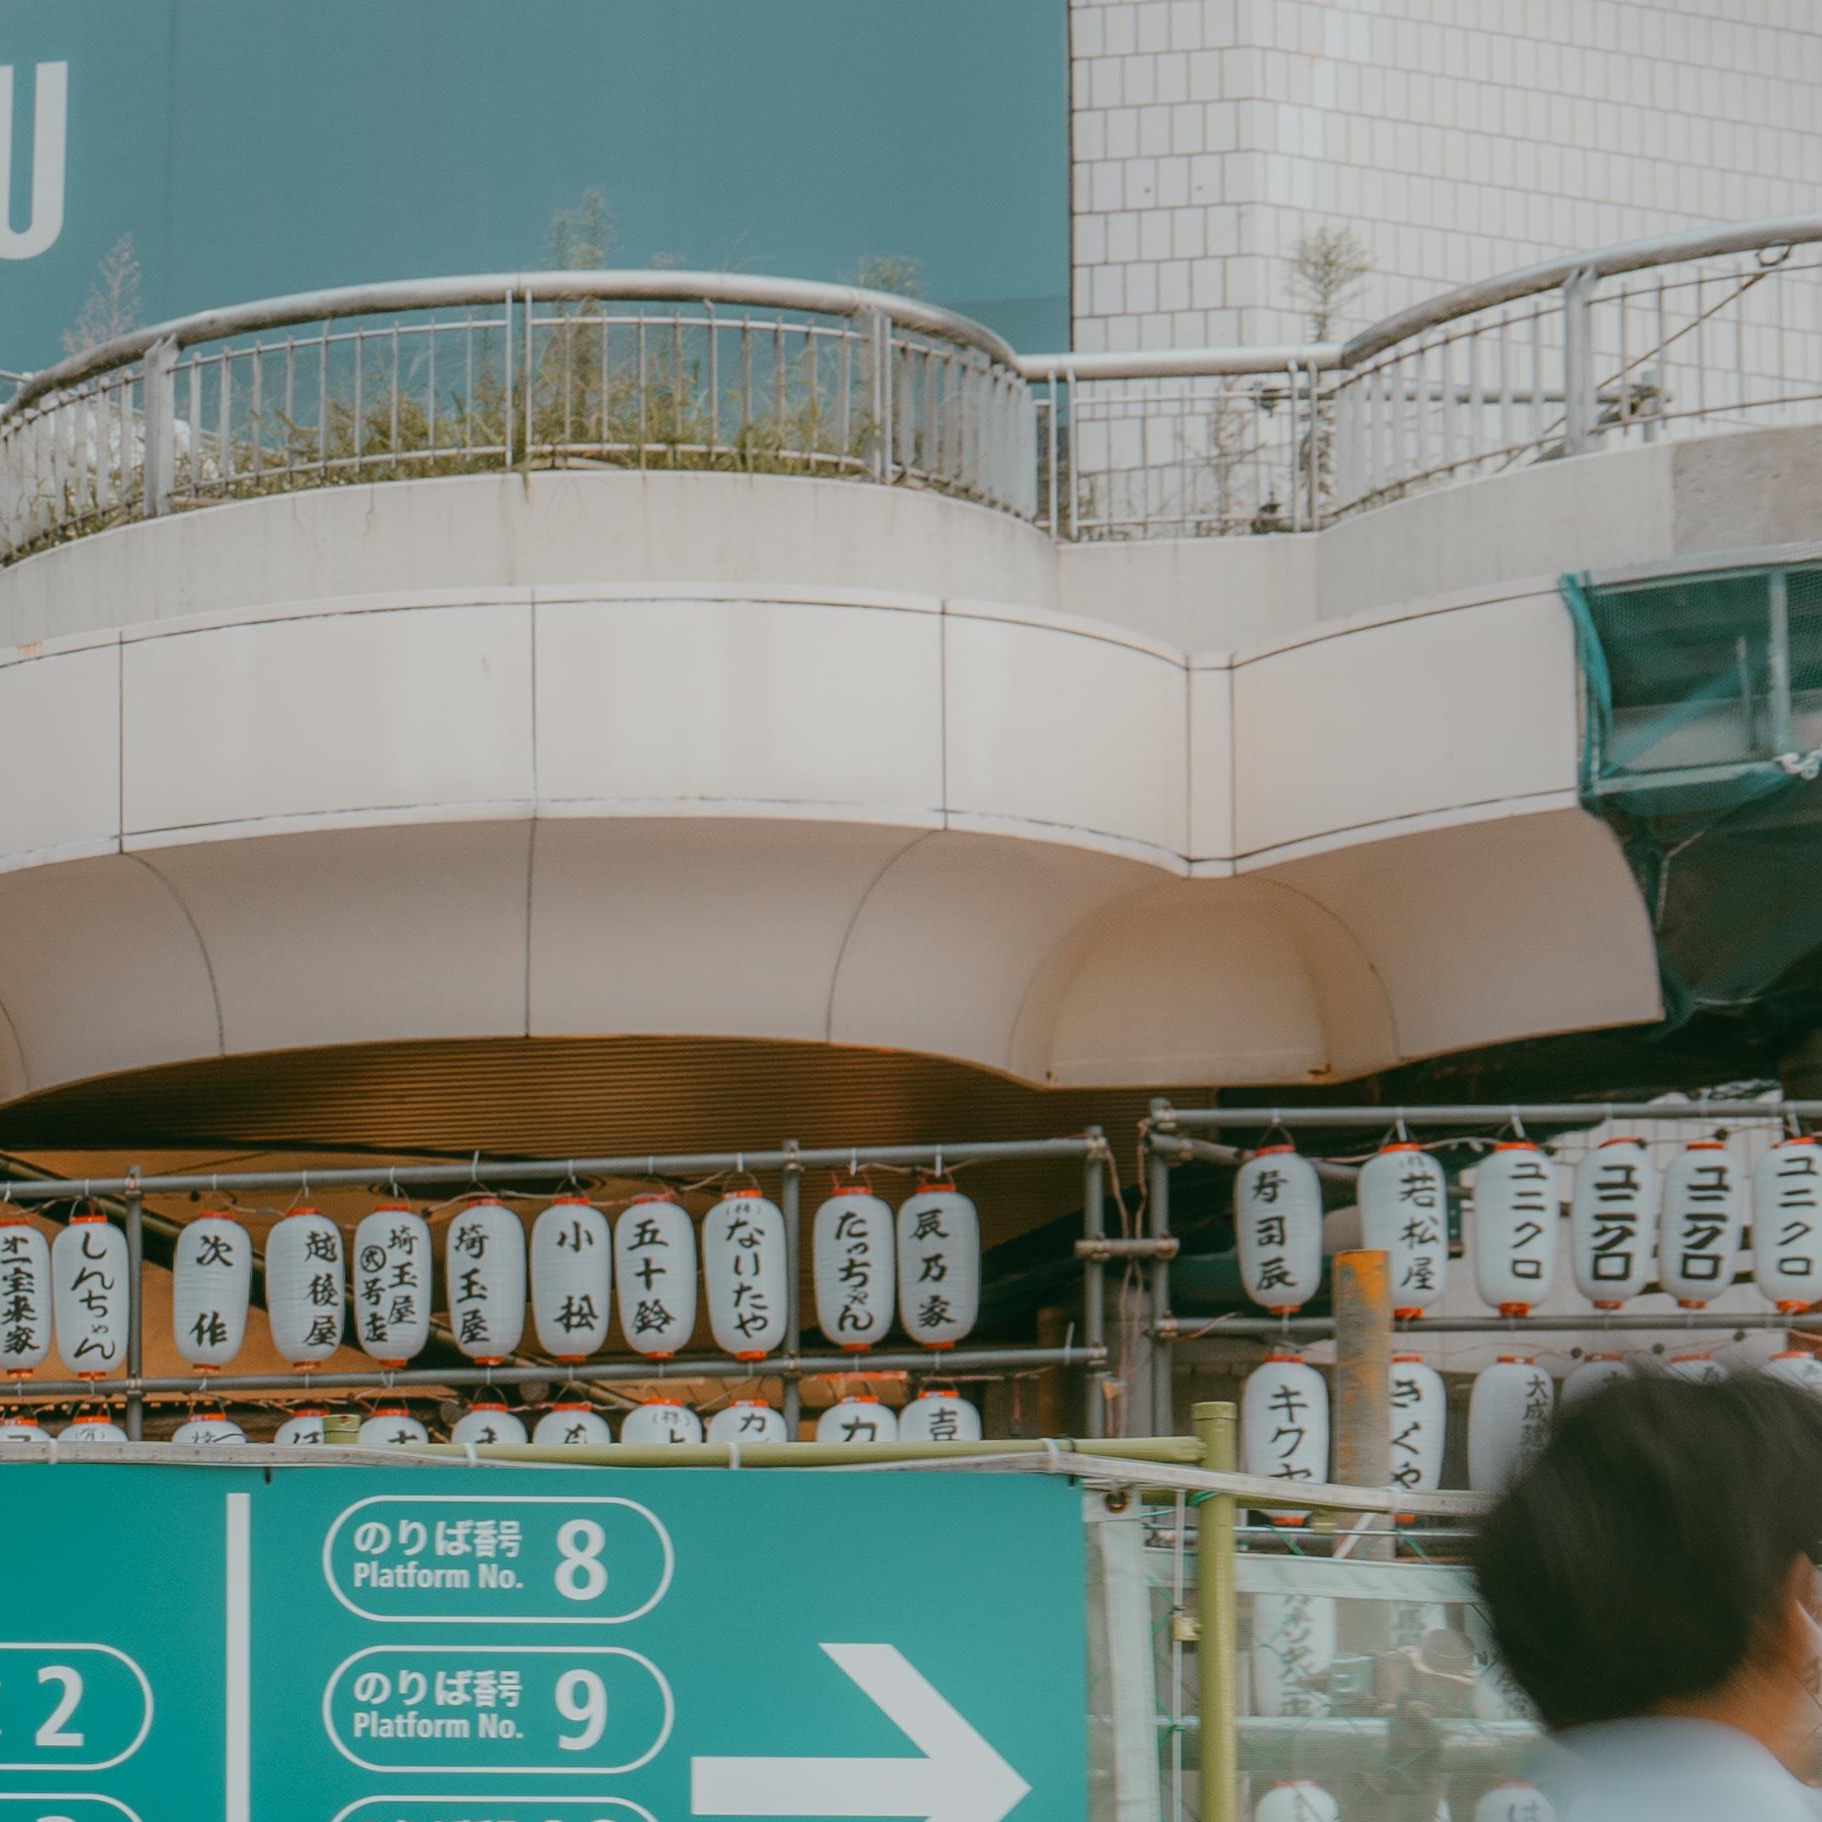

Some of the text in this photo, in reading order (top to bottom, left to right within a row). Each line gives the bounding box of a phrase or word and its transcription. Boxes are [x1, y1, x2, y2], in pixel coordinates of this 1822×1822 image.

[835, 1211, 874, 1332] たっちゃん
[1251, 1169, 1298, 1292] 寿司辰
[1509, 1161, 1549, 1280] ユニクロ
[1591, 1163, 1642, 1281] ユニクロ
[1680, 1165, 1732, 1281] ユニクロ
[1776, 1155, 1820, 1277] ユニクロ
[70, 1231, 116, 1360] しんちゃん
[304, 1230, 340, 1347] 越後屋
[454, 1223, 492, 1345] 埼玉屋
[553, 1220, 599, 1334] 小松
[627, 1218, 676, 1335] 五十鈴
[353, 1563, 524, 1590] Platform No.
[354, 1520, 522, 1558] のりば番号
[554, 1518, 608, 1601] 8
[35, 1665, 84, 1748] 2
[353, 1712, 524, 1741] Platform No.
[354, 1669, 522, 1708] のりば番号
[556, 1668, 608, 1752] 9
